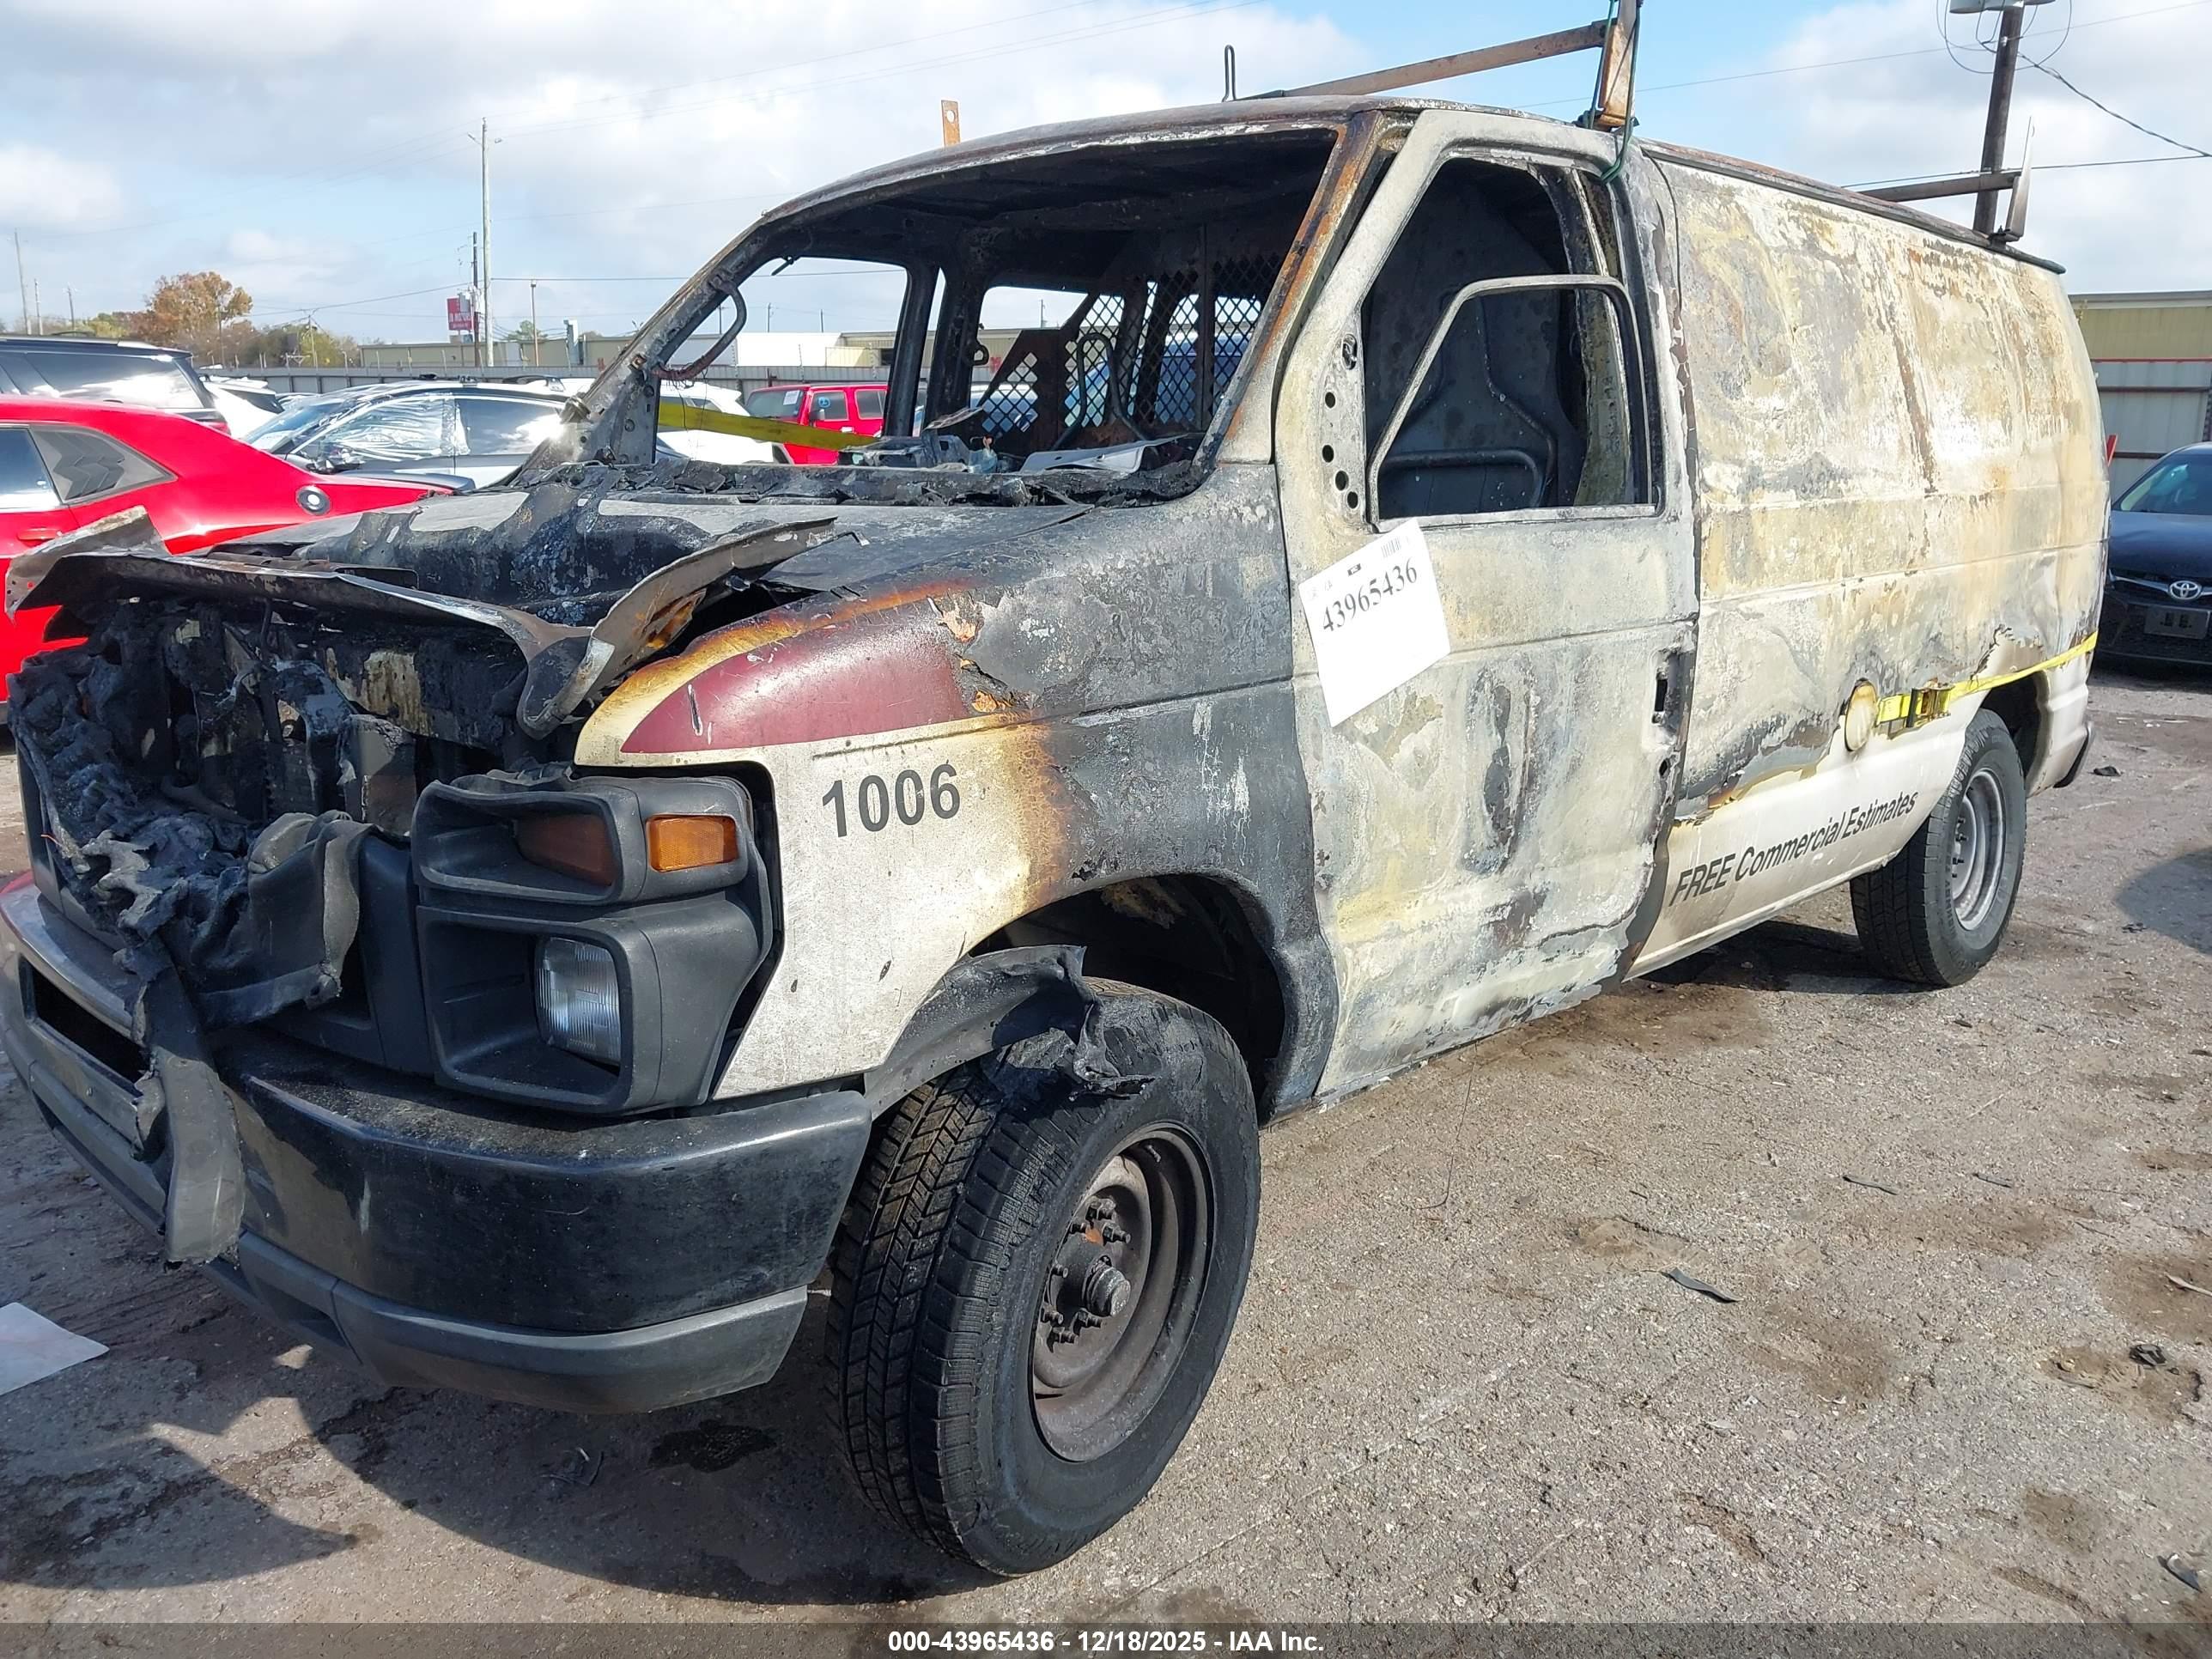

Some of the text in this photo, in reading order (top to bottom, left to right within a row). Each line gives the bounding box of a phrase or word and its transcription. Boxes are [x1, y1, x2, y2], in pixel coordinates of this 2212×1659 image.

[1322, 558, 1418, 632] 43965436
[822, 763, 961, 838] 1006
[1668, 791, 1919, 907] FREE Commercial Estimates
